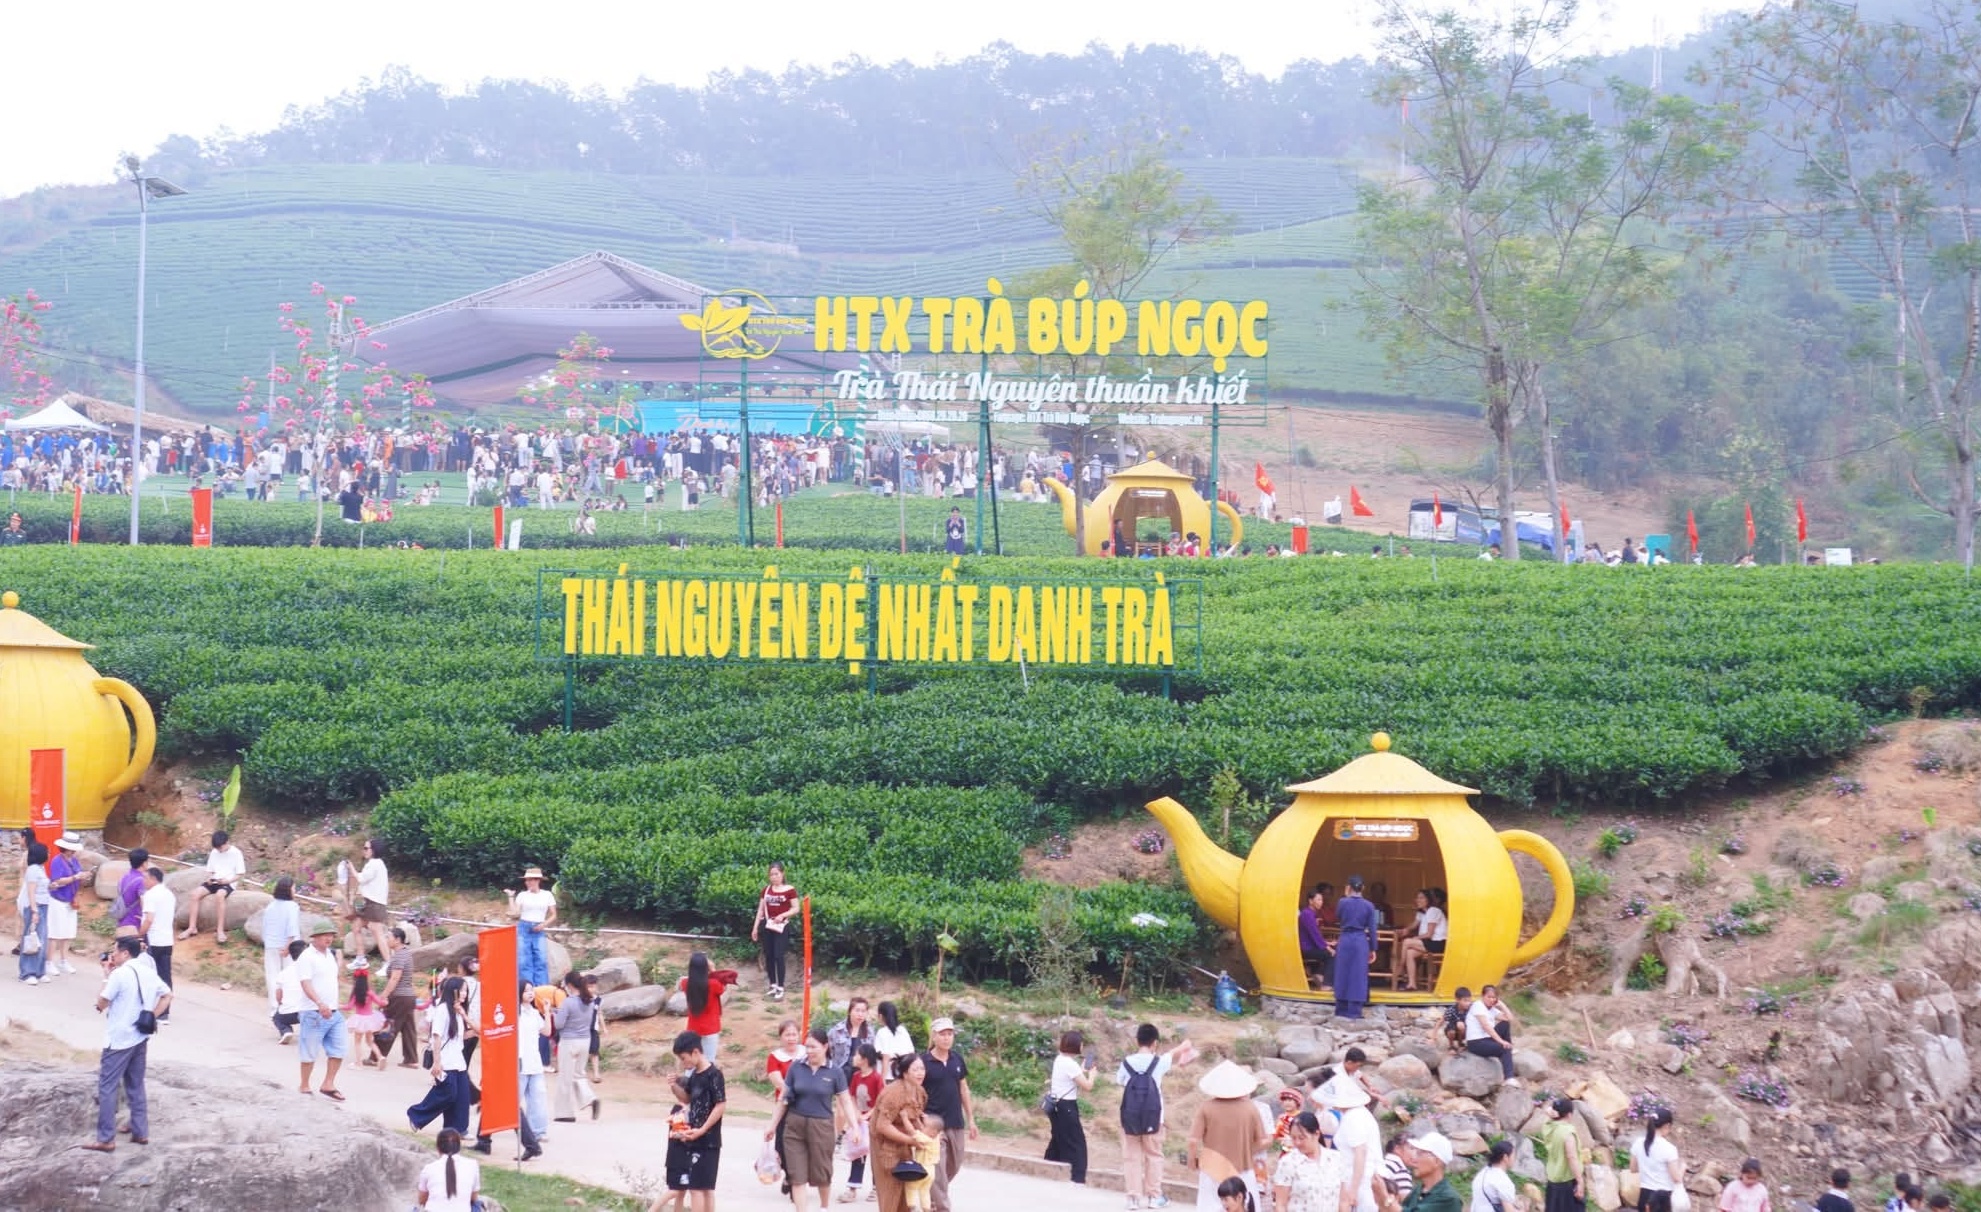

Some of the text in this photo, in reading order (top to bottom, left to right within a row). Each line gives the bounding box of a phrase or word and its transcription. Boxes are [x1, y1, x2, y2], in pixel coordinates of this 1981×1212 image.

[814, 278, 1269, 374] HTX TRÀ BÚP NGỌC
[832, 367, 1249, 411] Trà Thái Nguyên thuần khiết
[562, 556, 1174, 675] THÁI NGUYÊN ĐỆ NHẤT DANH TRÀ
